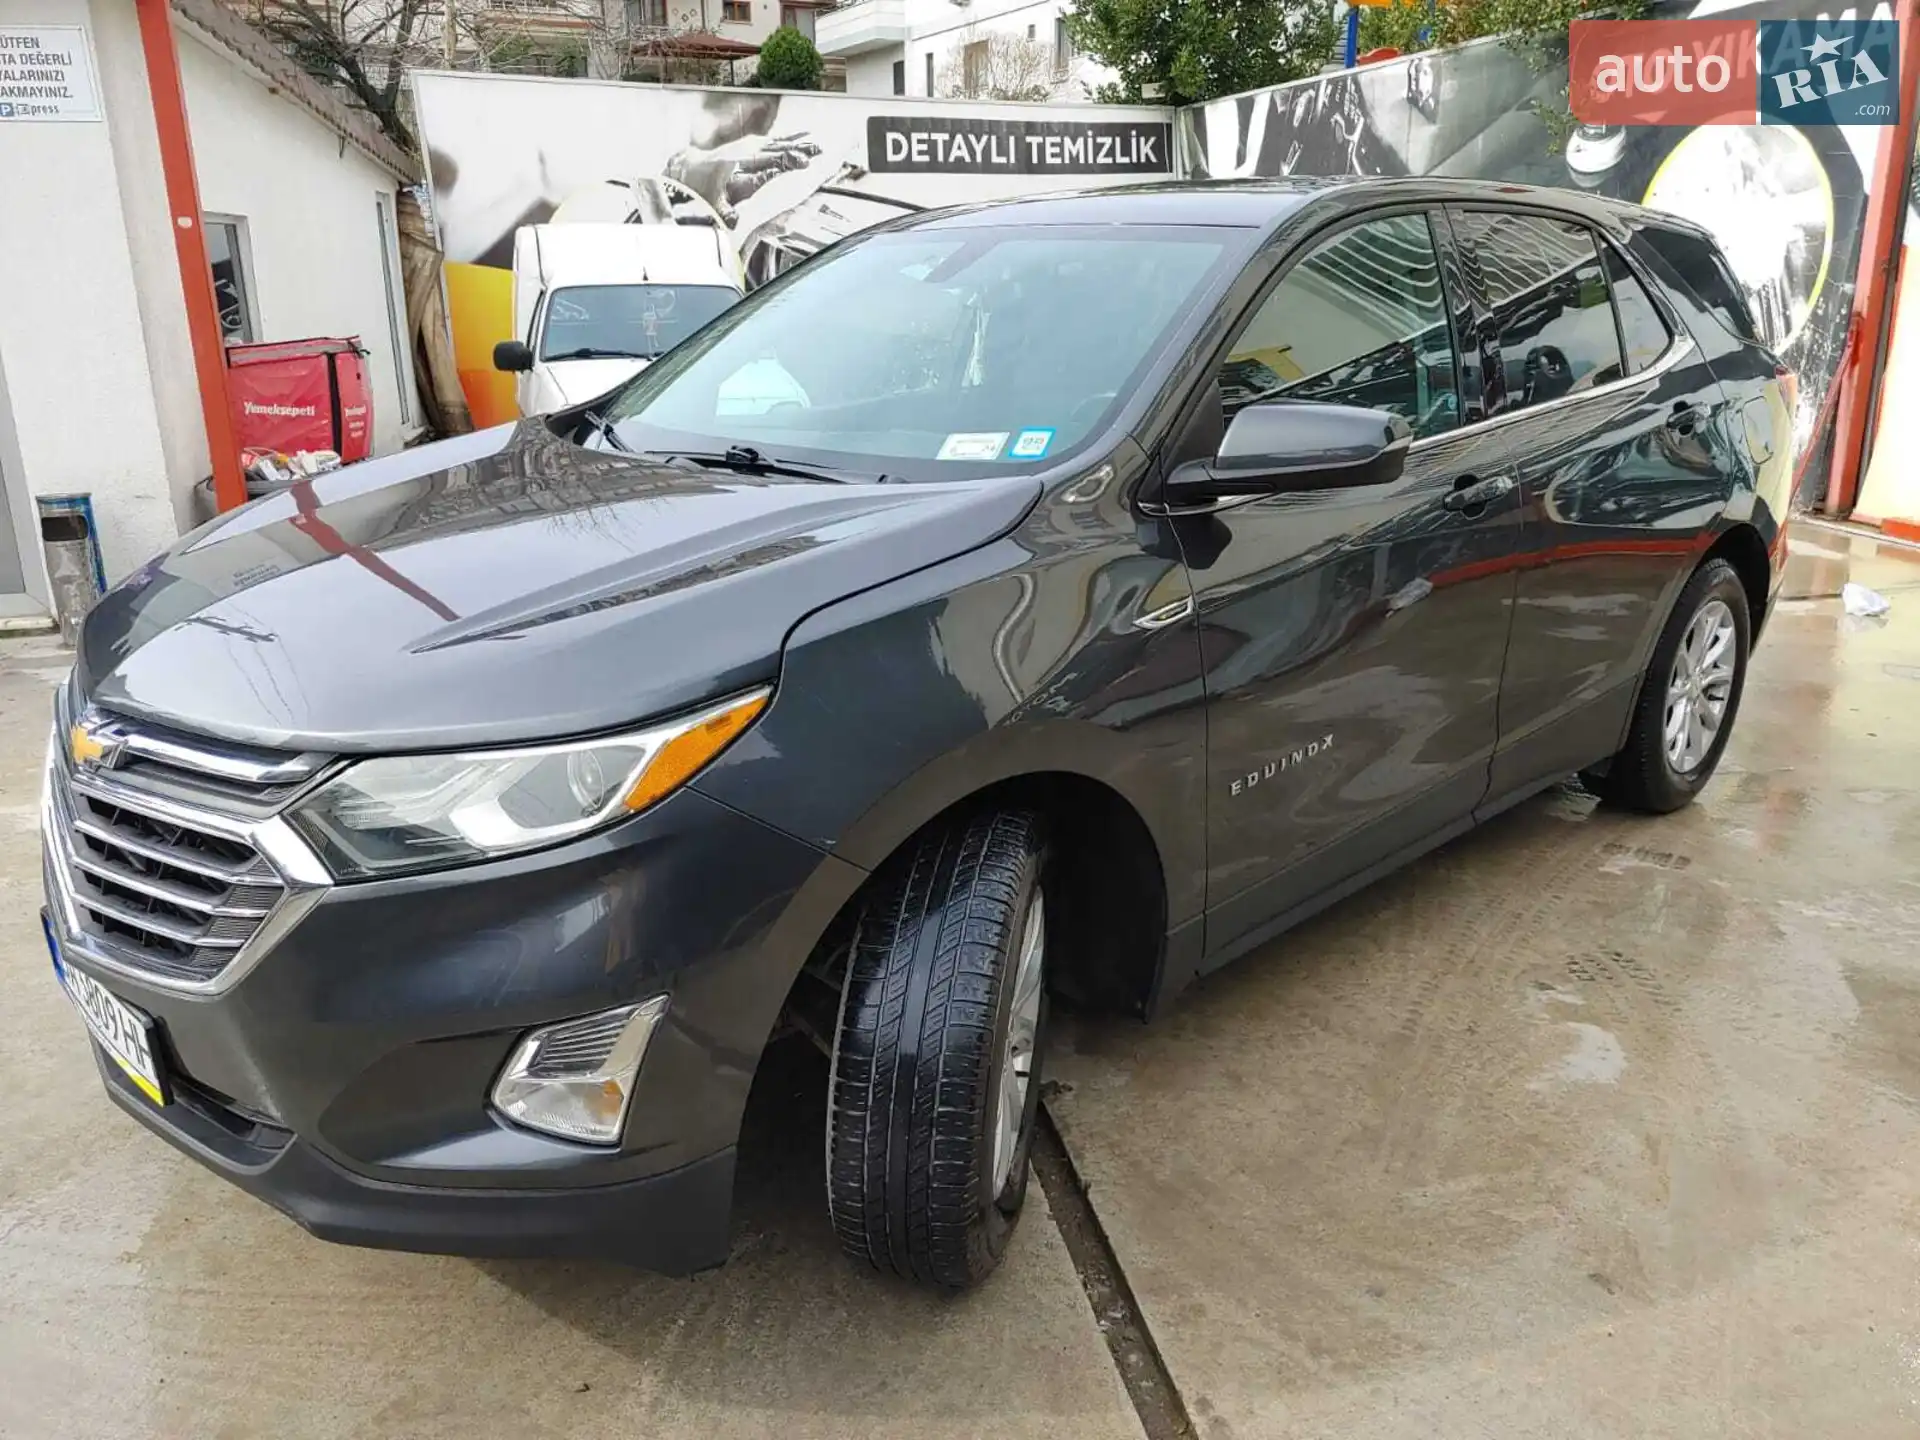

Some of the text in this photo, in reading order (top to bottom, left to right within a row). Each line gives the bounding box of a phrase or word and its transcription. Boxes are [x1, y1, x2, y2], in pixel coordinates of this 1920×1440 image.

[0, 35, 40, 49] ÜTFEN
[0, 49, 72, 66] TA DEĞERLİ
[885, 129, 1158, 164] DETAYLI TEMİZLİK
